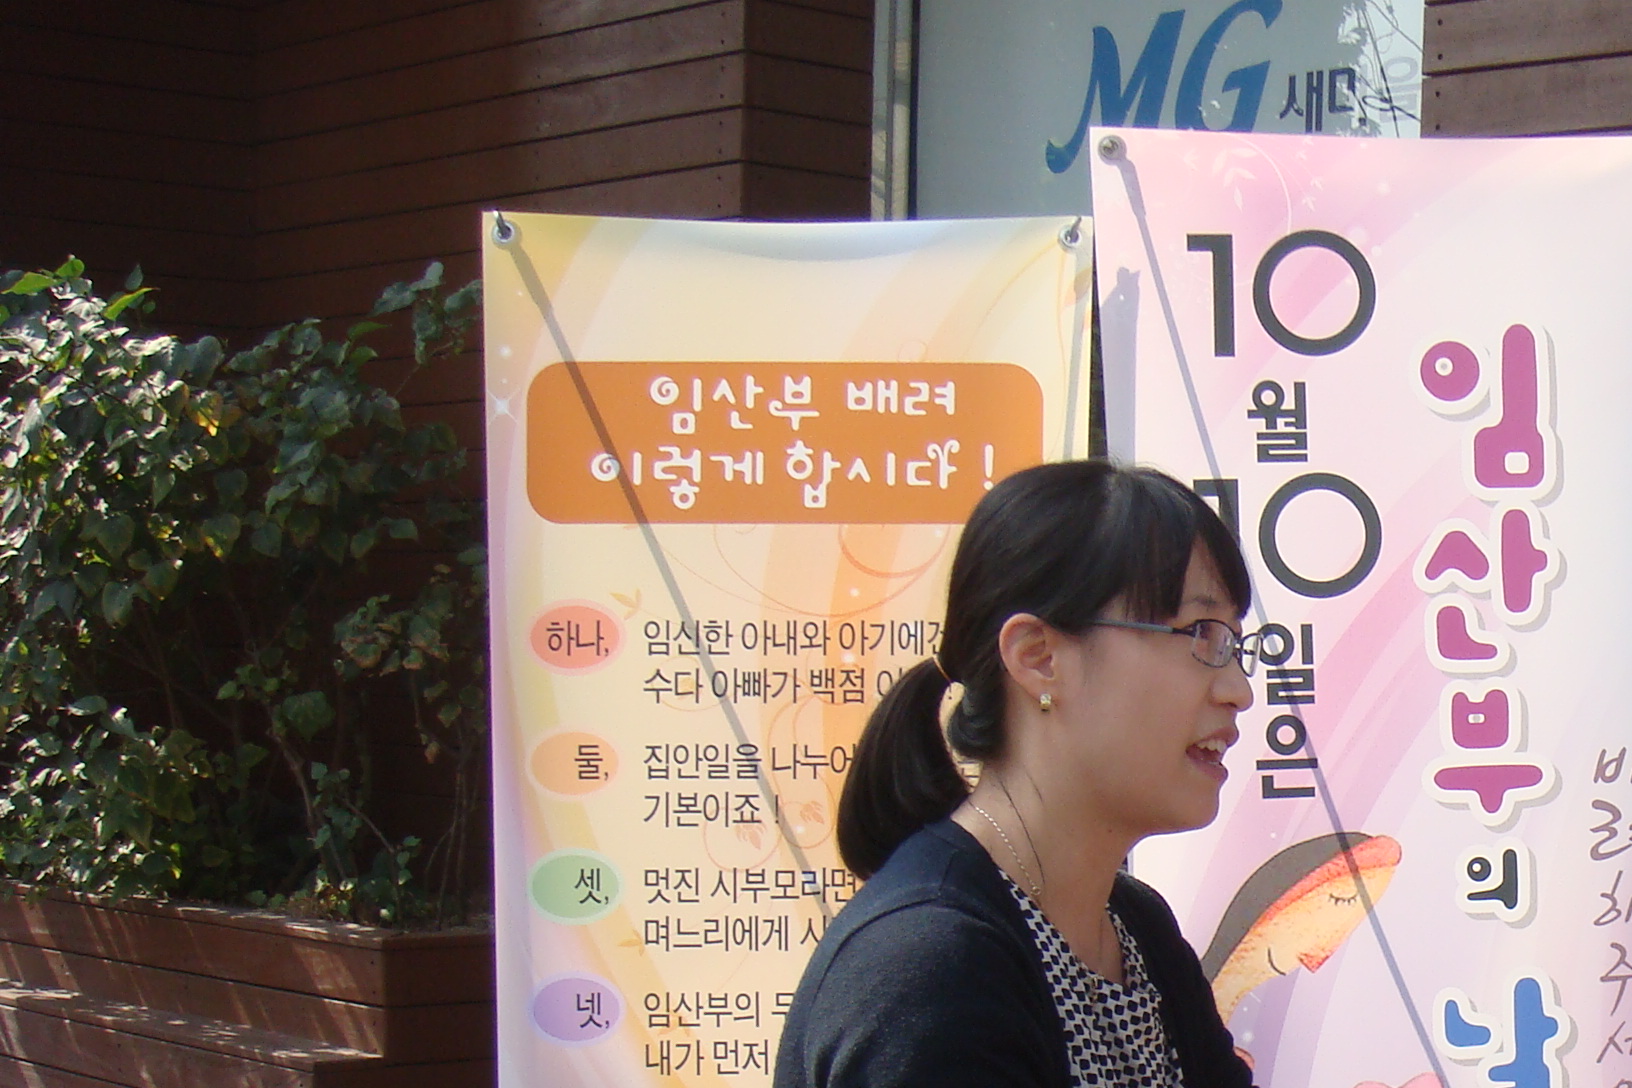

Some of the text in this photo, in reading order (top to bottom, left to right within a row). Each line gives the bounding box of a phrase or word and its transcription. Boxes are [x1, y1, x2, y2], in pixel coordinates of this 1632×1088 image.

[1045, 0, 1283, 174] MG
[650, 374, 957, 434] 임산부 배려
[591, 446, 766, 510] 이렇게
[785, 439, 959, 508] 합시다
[546, 620, 610, 658] 하나,
[643, 619, 733, 656] 임신한
[741, 619, 831, 656] 아내와
[643, 667, 703, 704] 수다
[711, 667, 800, 704] 아빠가
[809, 667, 866, 704] 백점
[574, 743, 610, 781] 둘,
[643, 742, 762, 780] 집안일을
[643, 791, 762, 828] 기본이죠
[574, 867, 610, 905] 셋,
[643, 867, 857, 904] 멋진 시부모라면
[643, 915, 789, 952] 며느리에게
[576, 991, 610, 1030] 넷,
[643, 991, 761, 1029] 임산부의
[644, 1039, 770, 1077] 내가 먼저
